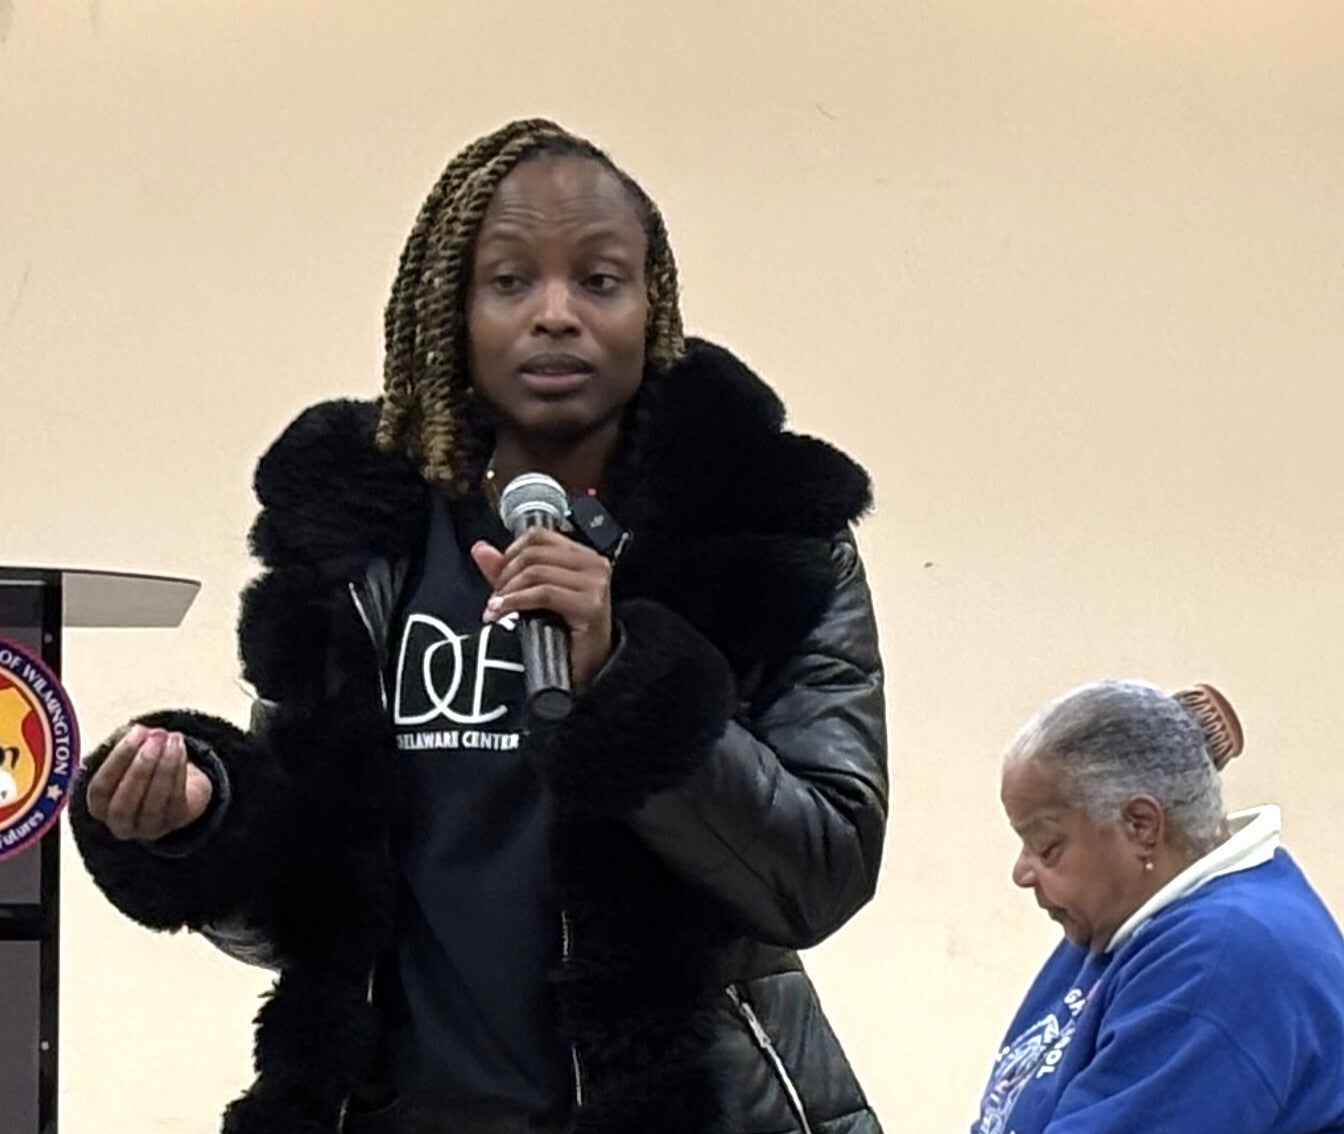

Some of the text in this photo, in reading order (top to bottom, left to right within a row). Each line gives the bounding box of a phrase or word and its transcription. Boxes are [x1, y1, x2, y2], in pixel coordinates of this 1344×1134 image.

[22, 663, 70, 776] WILMINGTON
[396, 730, 519, 751] DELAWARE CENTER
